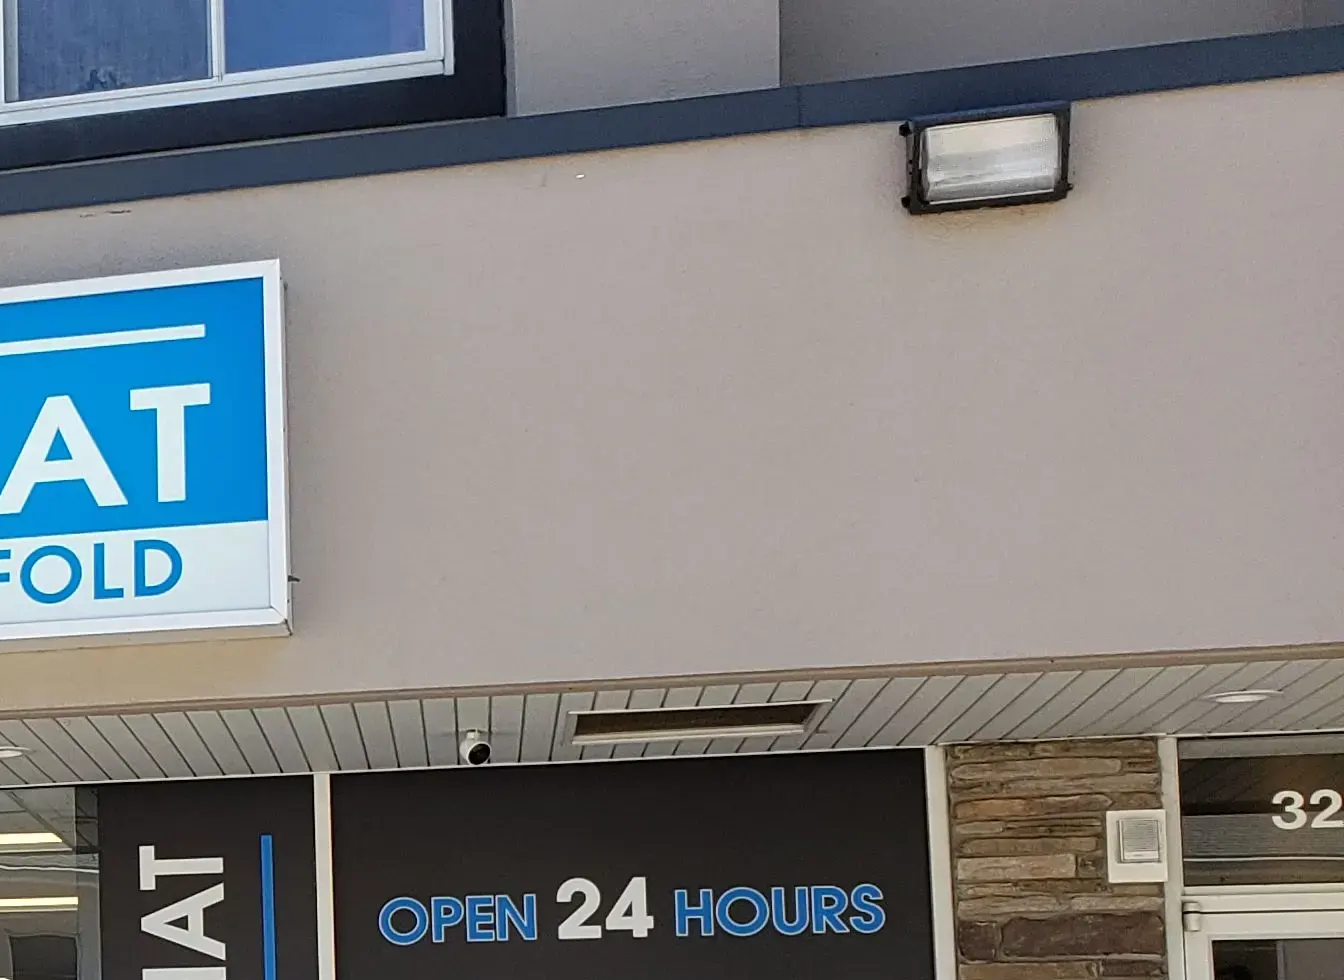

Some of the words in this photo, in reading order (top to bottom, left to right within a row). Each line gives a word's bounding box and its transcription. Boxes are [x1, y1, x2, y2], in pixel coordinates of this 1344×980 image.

[1271, 788, 1344, 830] 32
[378, 893, 538, 946] OPEN
[556, 877, 655, 940] 24
[674, 884, 887, 938] HOURS
